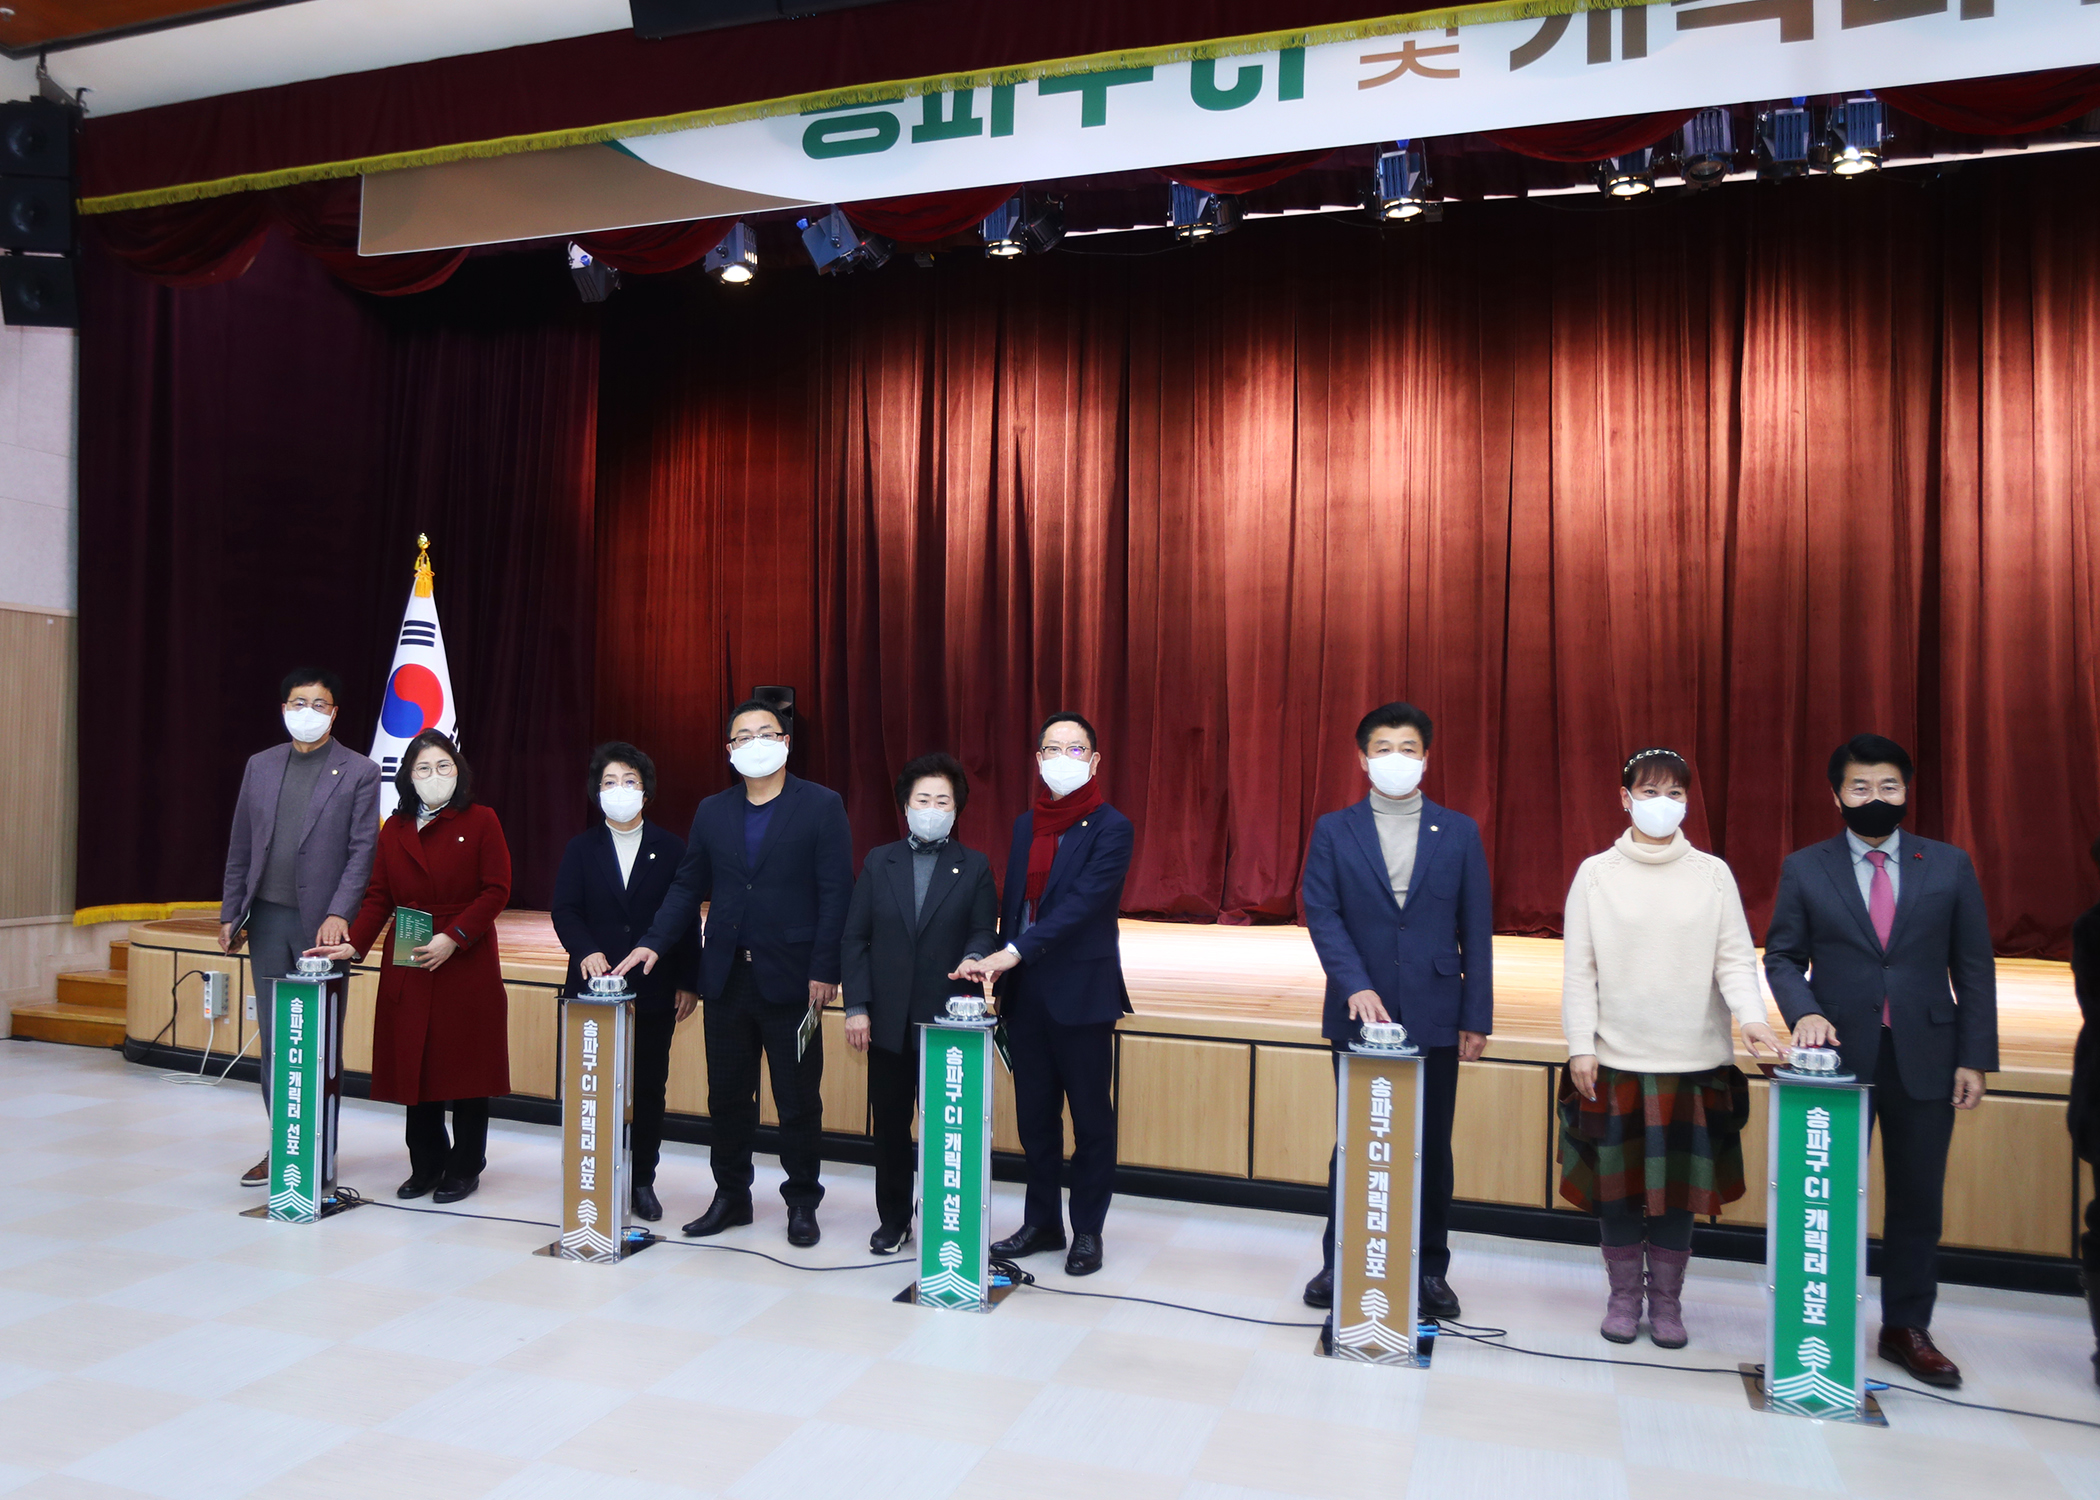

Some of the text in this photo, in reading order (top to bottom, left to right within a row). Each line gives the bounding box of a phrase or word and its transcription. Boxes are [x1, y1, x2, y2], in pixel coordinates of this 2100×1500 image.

[286, 997, 304, 1156] 송파구 CI 캐릭터 선포
[580, 1019, 599, 1191] 송파구 CI 캐릭터 선포
[942, 1046, 964, 1232] 송파구 CI 캐릭터 선포
[1365, 1076, 1393, 1279] 송파구 CI 캐릭터 선포
[1802, 1107, 1831, 1326] 송파구 CI 캐릭터 선포
